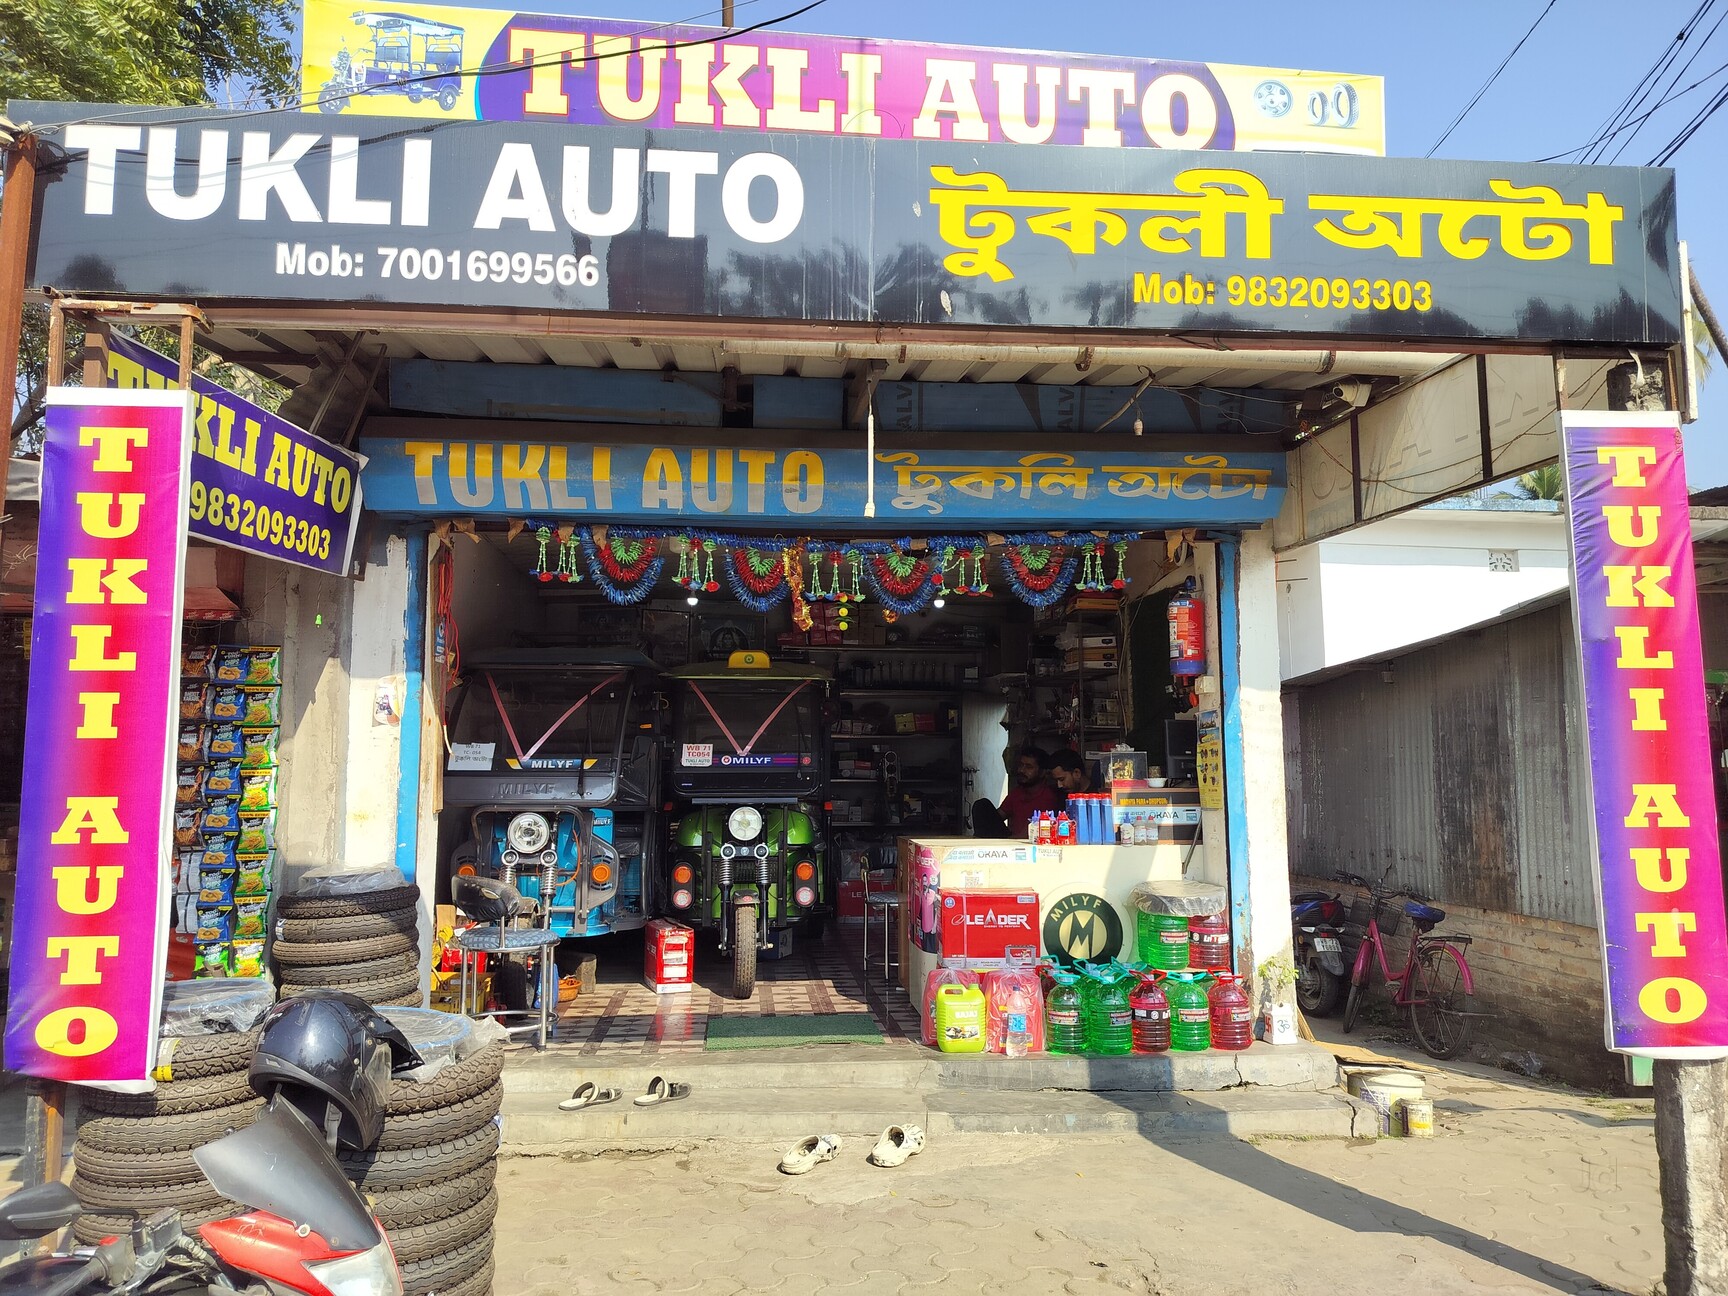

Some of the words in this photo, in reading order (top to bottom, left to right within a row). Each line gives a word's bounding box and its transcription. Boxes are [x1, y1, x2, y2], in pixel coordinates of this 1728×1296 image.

[508, 27, 881, 137] TUKLI
[913, 57, 1218, 151] AUTO
[65, 124, 432, 227] TUKLI
[473, 140, 805, 244] AUTO
[929, 165, 1284, 282] টুকলী
[1308, 179, 1624, 265] অটো
[275, 242, 364, 279] Mob:
[377, 246, 600, 287] 7001699566
[1133, 271, 1216, 309] Mob:
[1227, 275, 1433, 313] 9832093303
[265, 431, 351, 514] AUTO
[405, 441, 612, 510] TUKLI
[642, 447, 824, 514] AUTO
[875, 452, 1094, 514] টুকলি
[1102, 454, 1272, 500] অটো
[190, 480, 331, 561] 9832093303
[66, 427, 148, 739] TUKLI
[1596, 446, 1675, 731] TUKLI
[531, 760, 574, 769] MILYF
[977, 850, 1008, 859] OKAYA
[35, 796, 129, 1057] AUTO
[1050, 895, 1103, 922] MILYF
[1624, 783, 1708, 1024] AUTO
